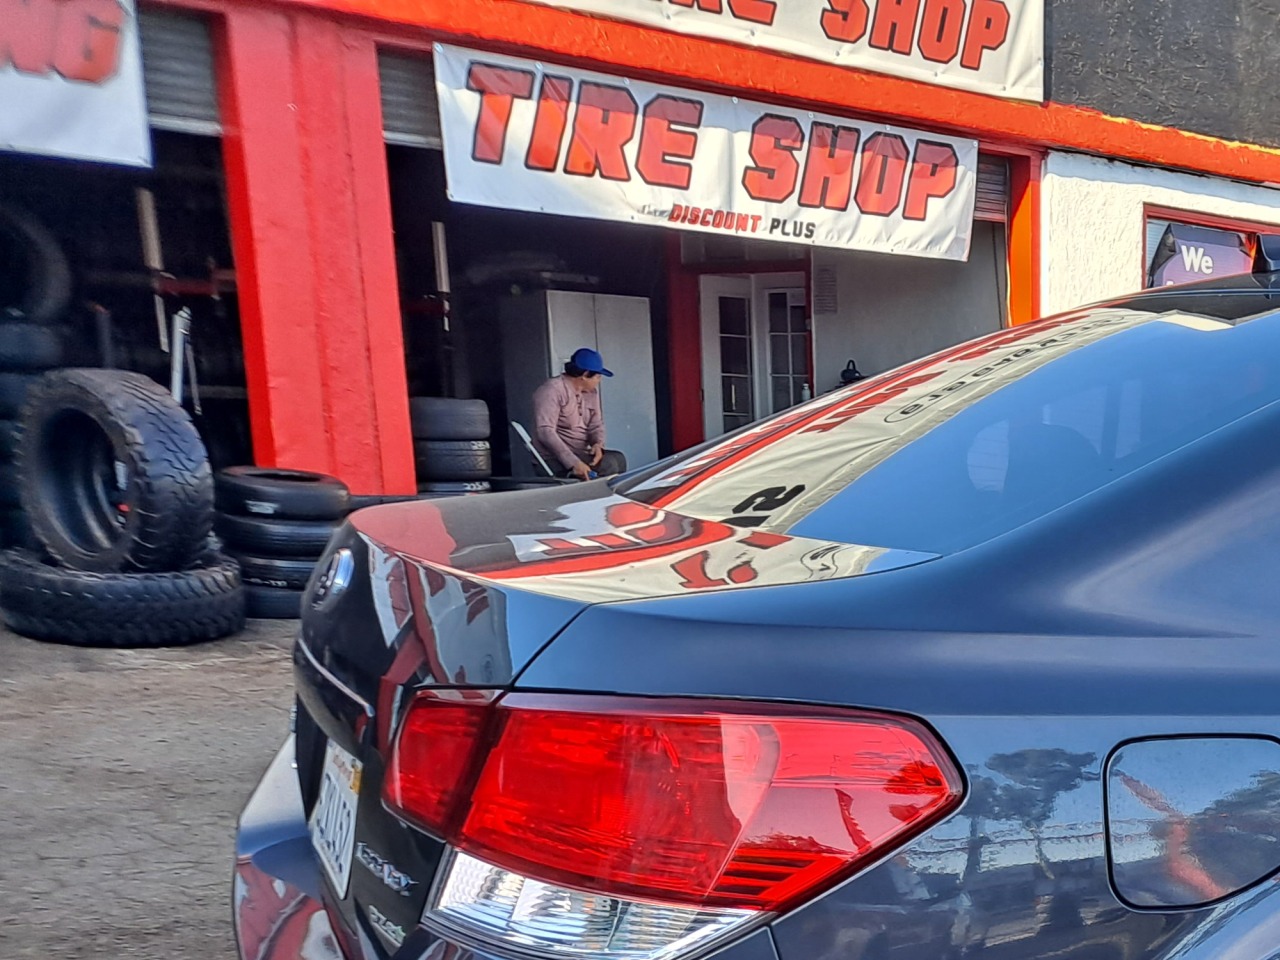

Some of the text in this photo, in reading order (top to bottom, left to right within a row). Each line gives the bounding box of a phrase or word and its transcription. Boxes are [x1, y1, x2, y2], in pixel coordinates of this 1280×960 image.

[820, 0, 1010, 71] SHOP
[466, 60, 960, 221] TIRE SHOP
[667, 203, 762, 233] DISCOUNT
[769, 217, 817, 239] PLUS
[1180, 244, 1214, 275] We
